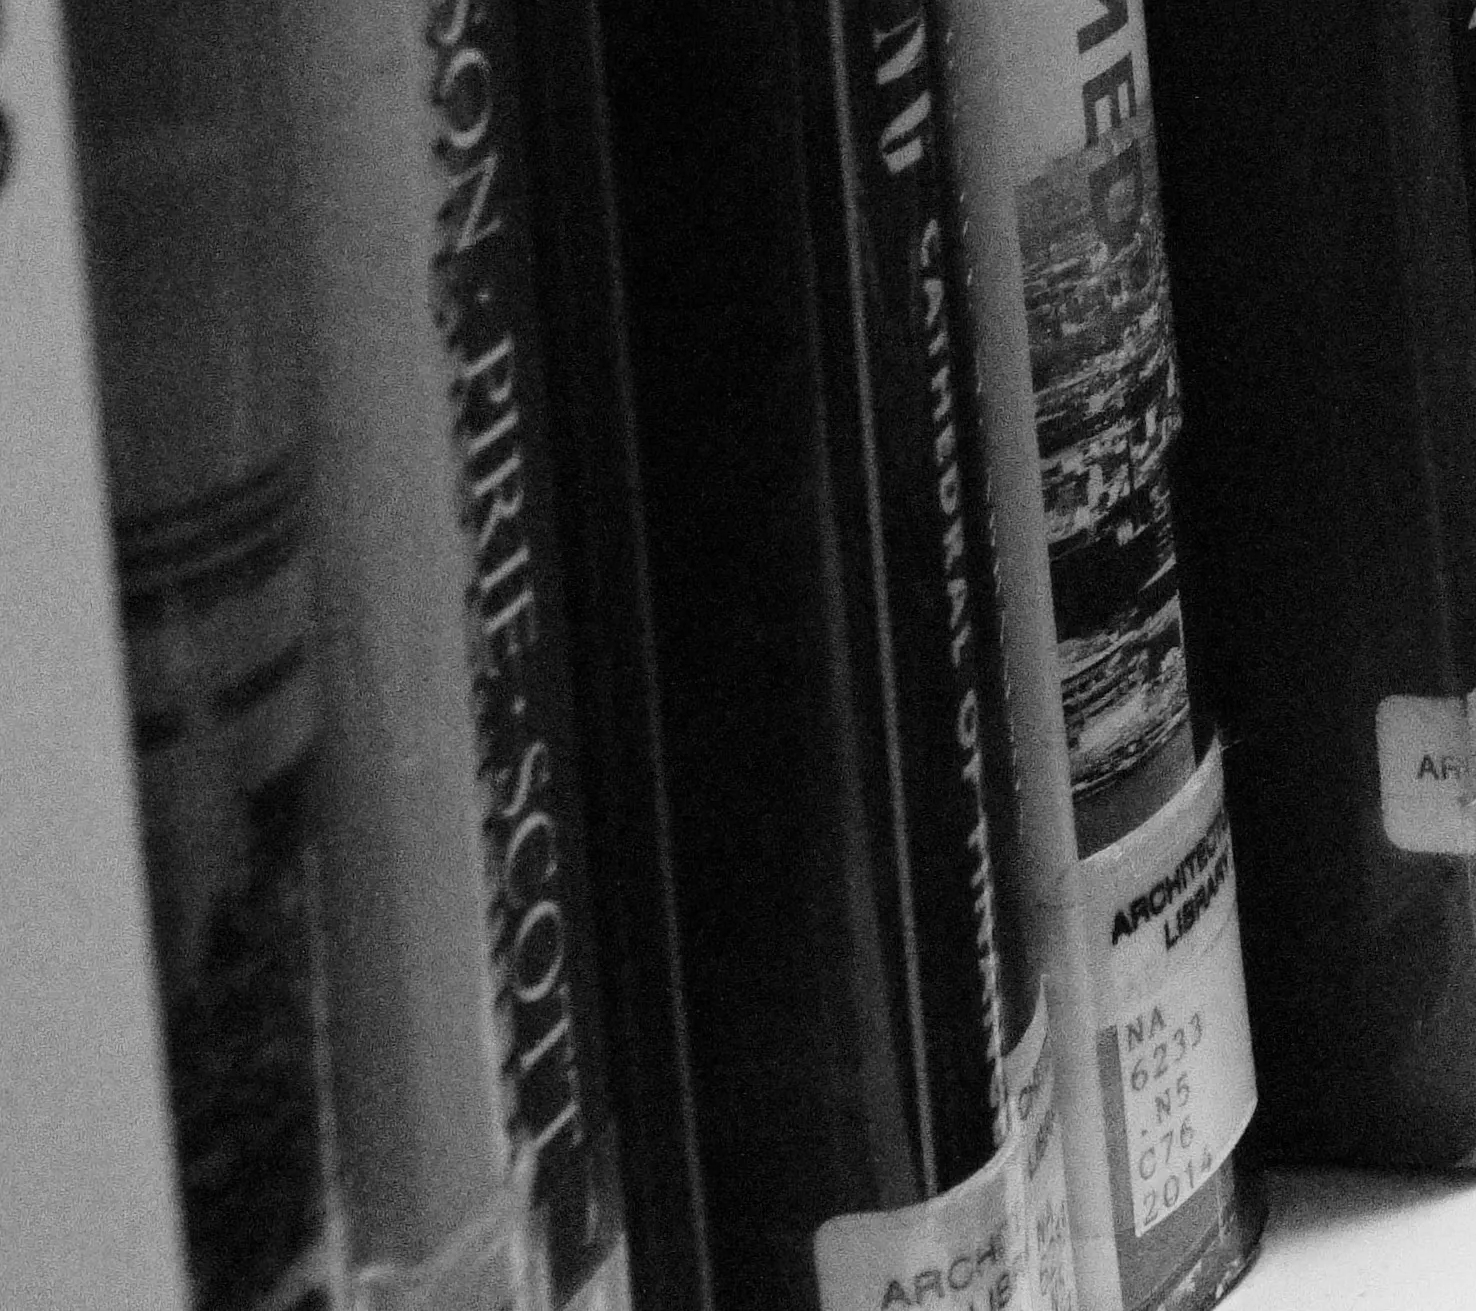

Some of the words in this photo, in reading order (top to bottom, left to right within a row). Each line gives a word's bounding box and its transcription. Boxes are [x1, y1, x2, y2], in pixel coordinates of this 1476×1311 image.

[462, 339, 535, 669] PIRIE
[915, 217, 976, 669] CATHEDRAL
[955, 687, 986, 781] OF
[488, 741, 586, 1157] SCOTT
[1126, 1006, 1167, 1054] NA
[1132, 1011, 1203, 1092] 6233
[1138, 1124, 1197, 1182] C76
